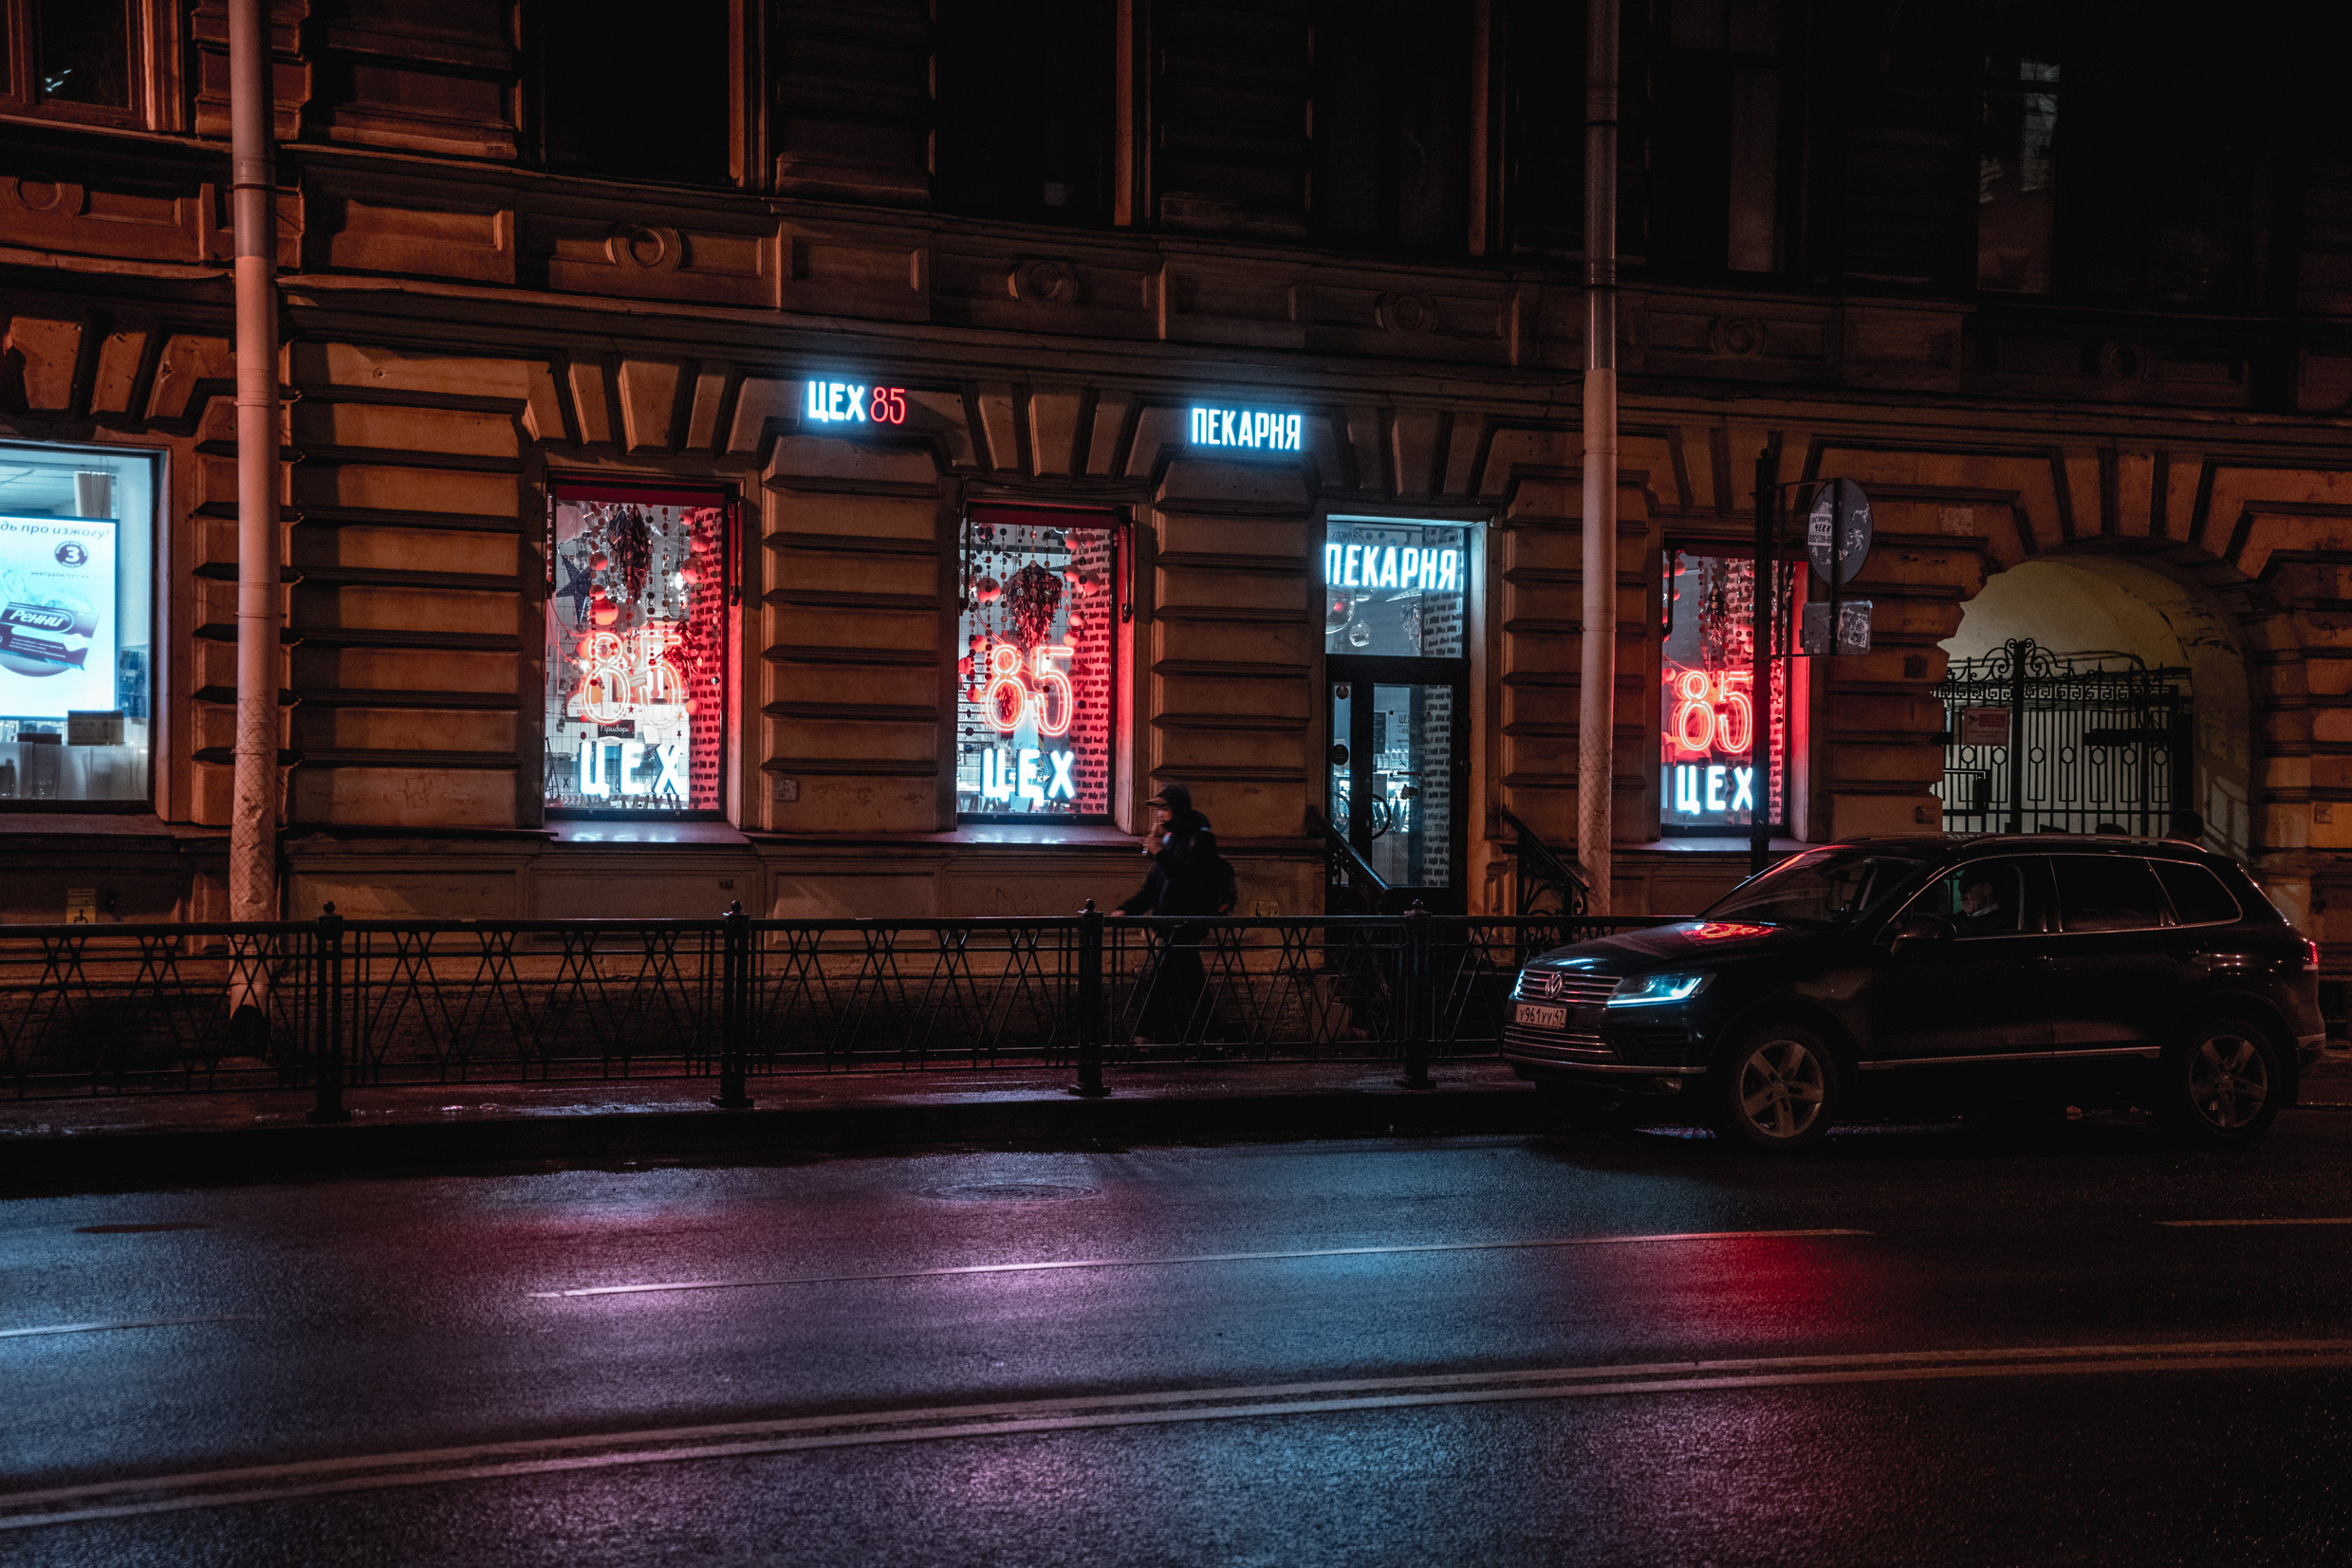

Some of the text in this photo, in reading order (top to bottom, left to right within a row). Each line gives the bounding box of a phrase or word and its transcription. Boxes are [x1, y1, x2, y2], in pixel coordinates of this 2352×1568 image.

[807, 380, 906, 425] ЦЕХ 85
[1192, 407, 1301, 451] ПЕКАРНЯ
[21, 525, 49, 536] про
[52, 526, 111, 540] изжогу!
[65, 546, 81, 563] 3
[1324, 543, 1457, 590] ПЕКАРНЯ
[9, 609, 65, 628] Ренни
[583, 632, 682, 729] 85
[985, 644, 1074, 736] 85
[1678, 669, 1753, 754] 85
[579, 741, 686, 799] ЦЕХ
[980, 747, 1075, 802] ЦЕХ
[1676, 765, 1753, 815] ЦЕХ
